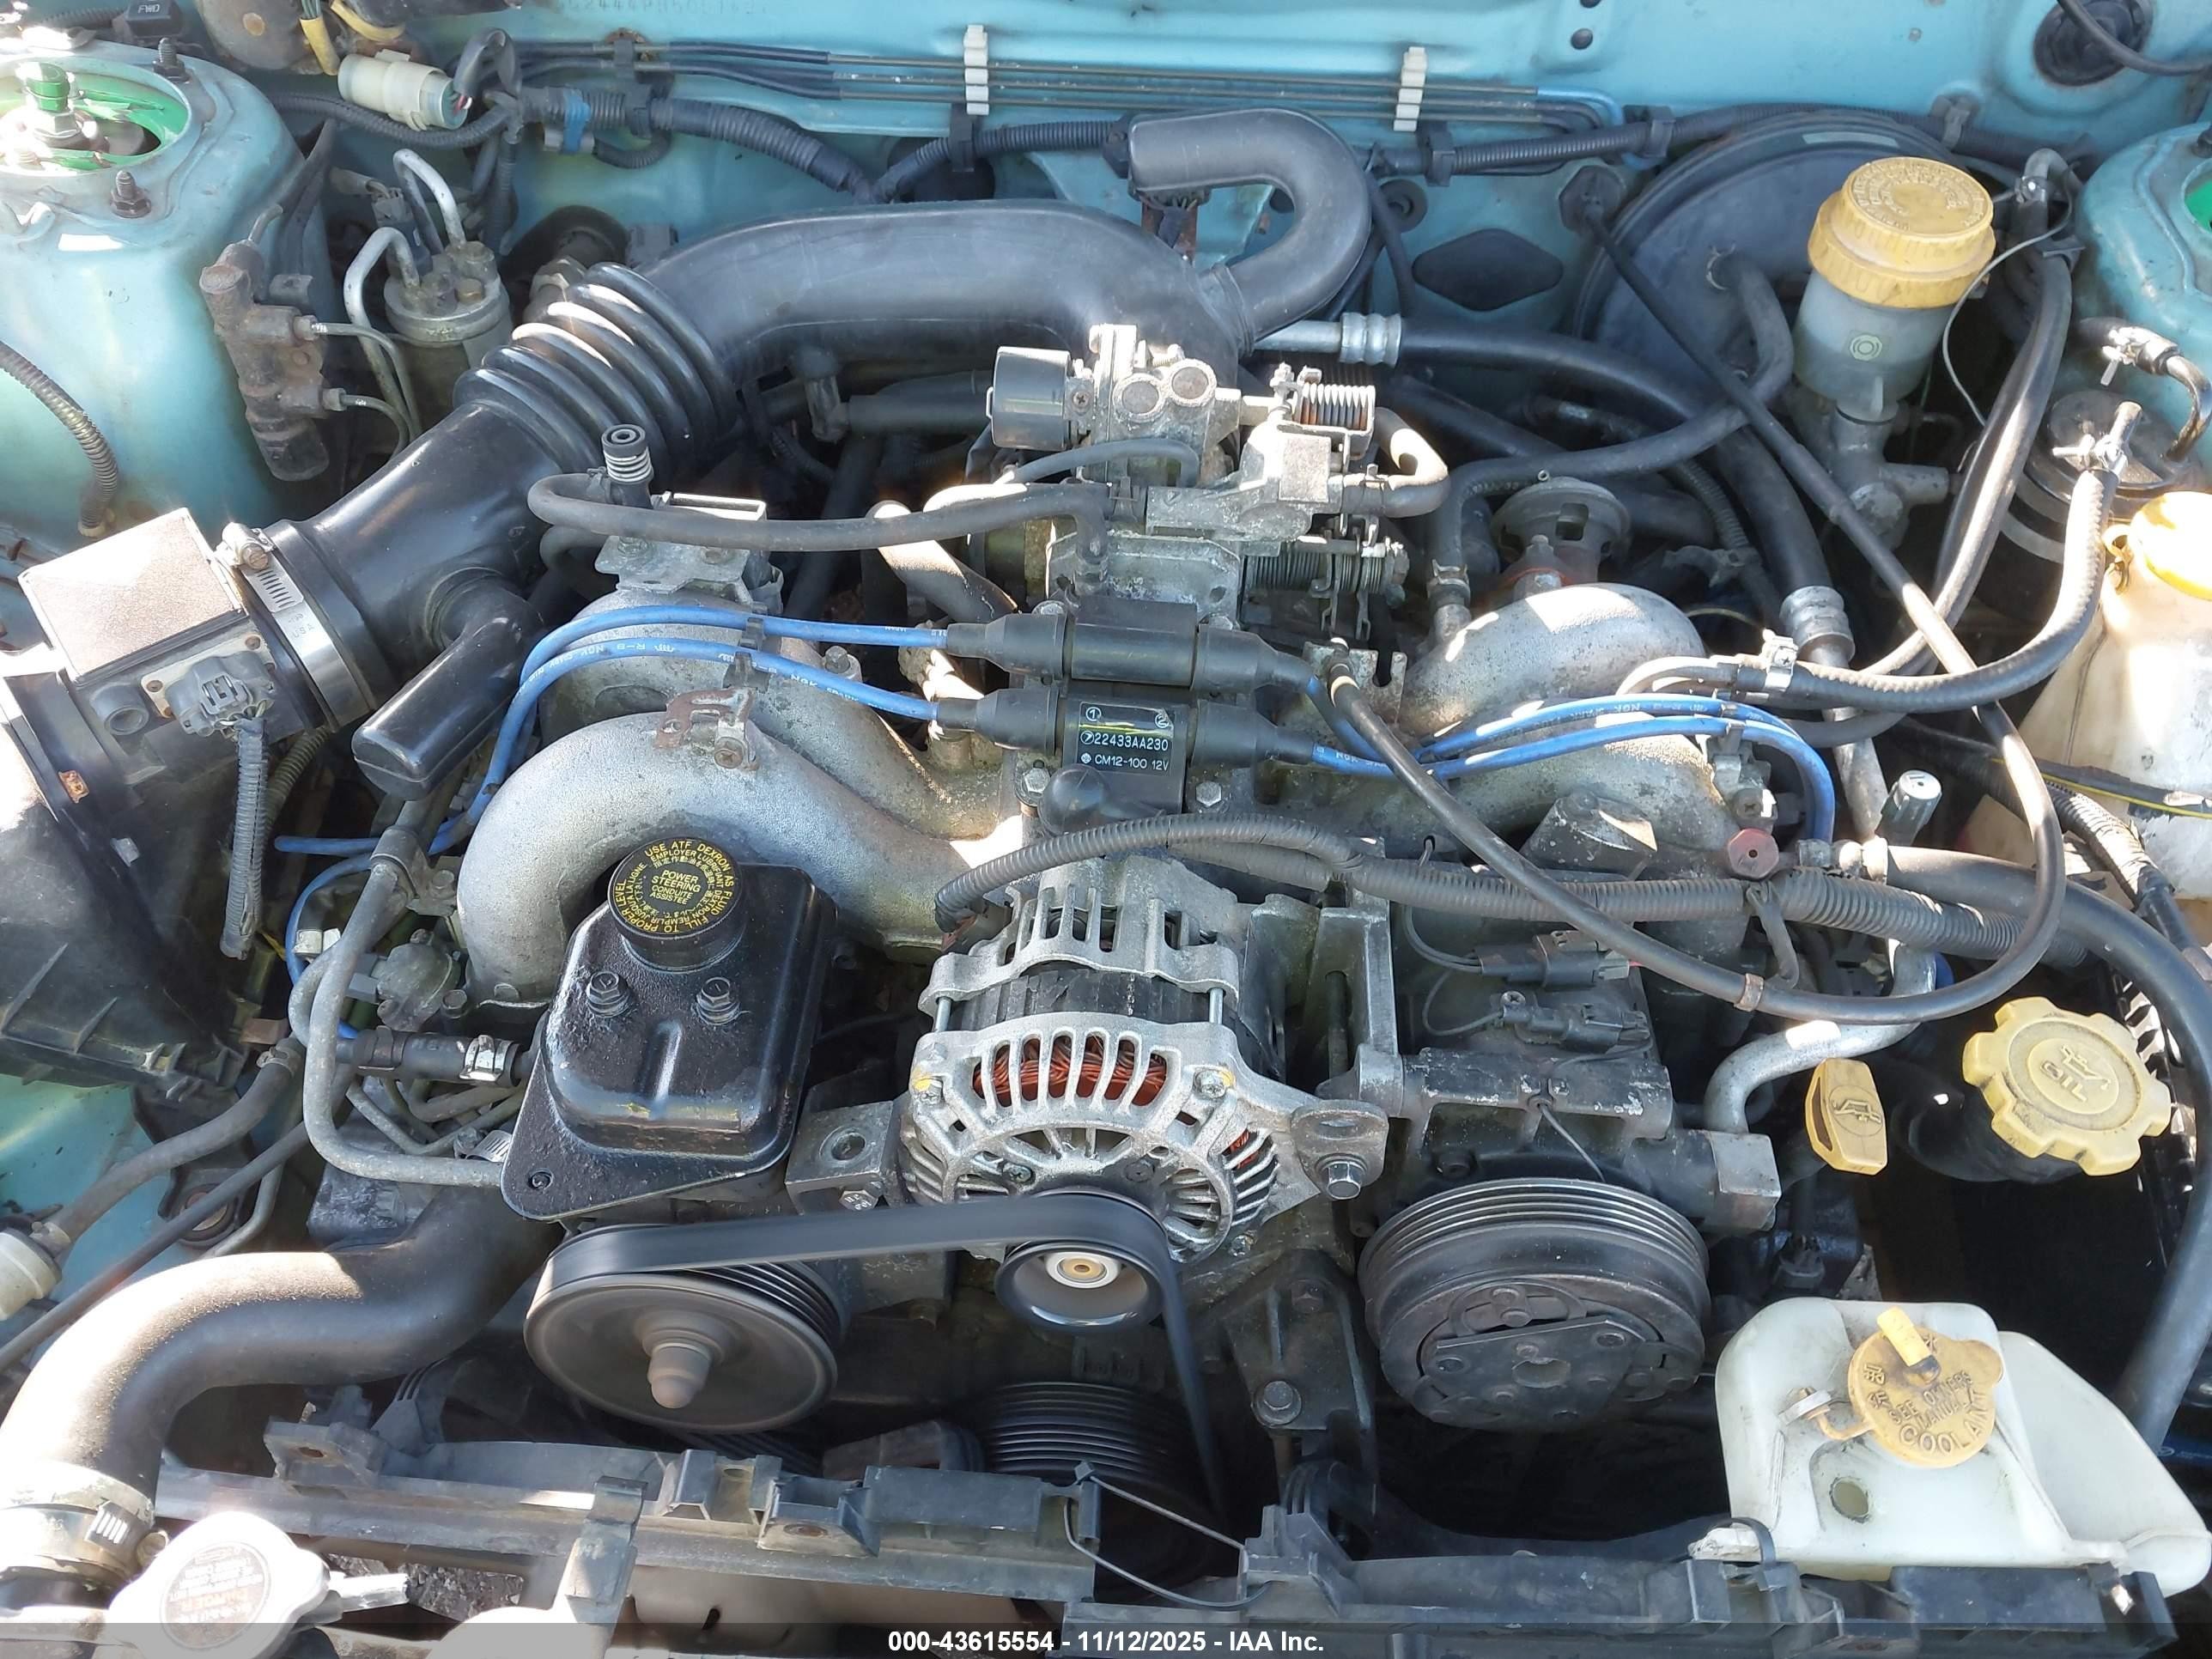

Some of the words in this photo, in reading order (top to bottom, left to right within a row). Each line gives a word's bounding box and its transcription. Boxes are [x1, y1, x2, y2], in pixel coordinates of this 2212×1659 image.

[137, 3, 161, 14] FWD
[1094, 732, 1169, 751] 22433AA230
[1094, 754, 1147, 769] CM12-100
[1152, 760, 1169, 771] 12V
[645, 843, 666, 857] USE
[672, 841, 692, 849] ATF
[650, 849, 697, 862] EMPLOYER
[697, 843, 732, 872] DEXRON
[661, 870, 699, 884] POWER
[697, 854, 724, 888] LUBRIFIANT
[651, 875, 701, 893] STEERING
[725, 875, 734, 887] AS
[649, 891, 688, 905] ASSISTEE
[651, 884, 694, 900] CONDUITE
[692, 890, 722, 918] DEXTRON
[711, 890, 732, 915] FLUID
[622, 908, 659, 933] PROPER
[651, 915, 690, 926] REMPLIR
[687, 916, 708, 929] FILL
[2040, 1059, 2088, 1103] OIL
[1888, 1400, 1920, 1425] SEE
[1916, 1386, 1970, 1430] MANUAL
[1899, 1388, 1989, 1454] COOLANT
